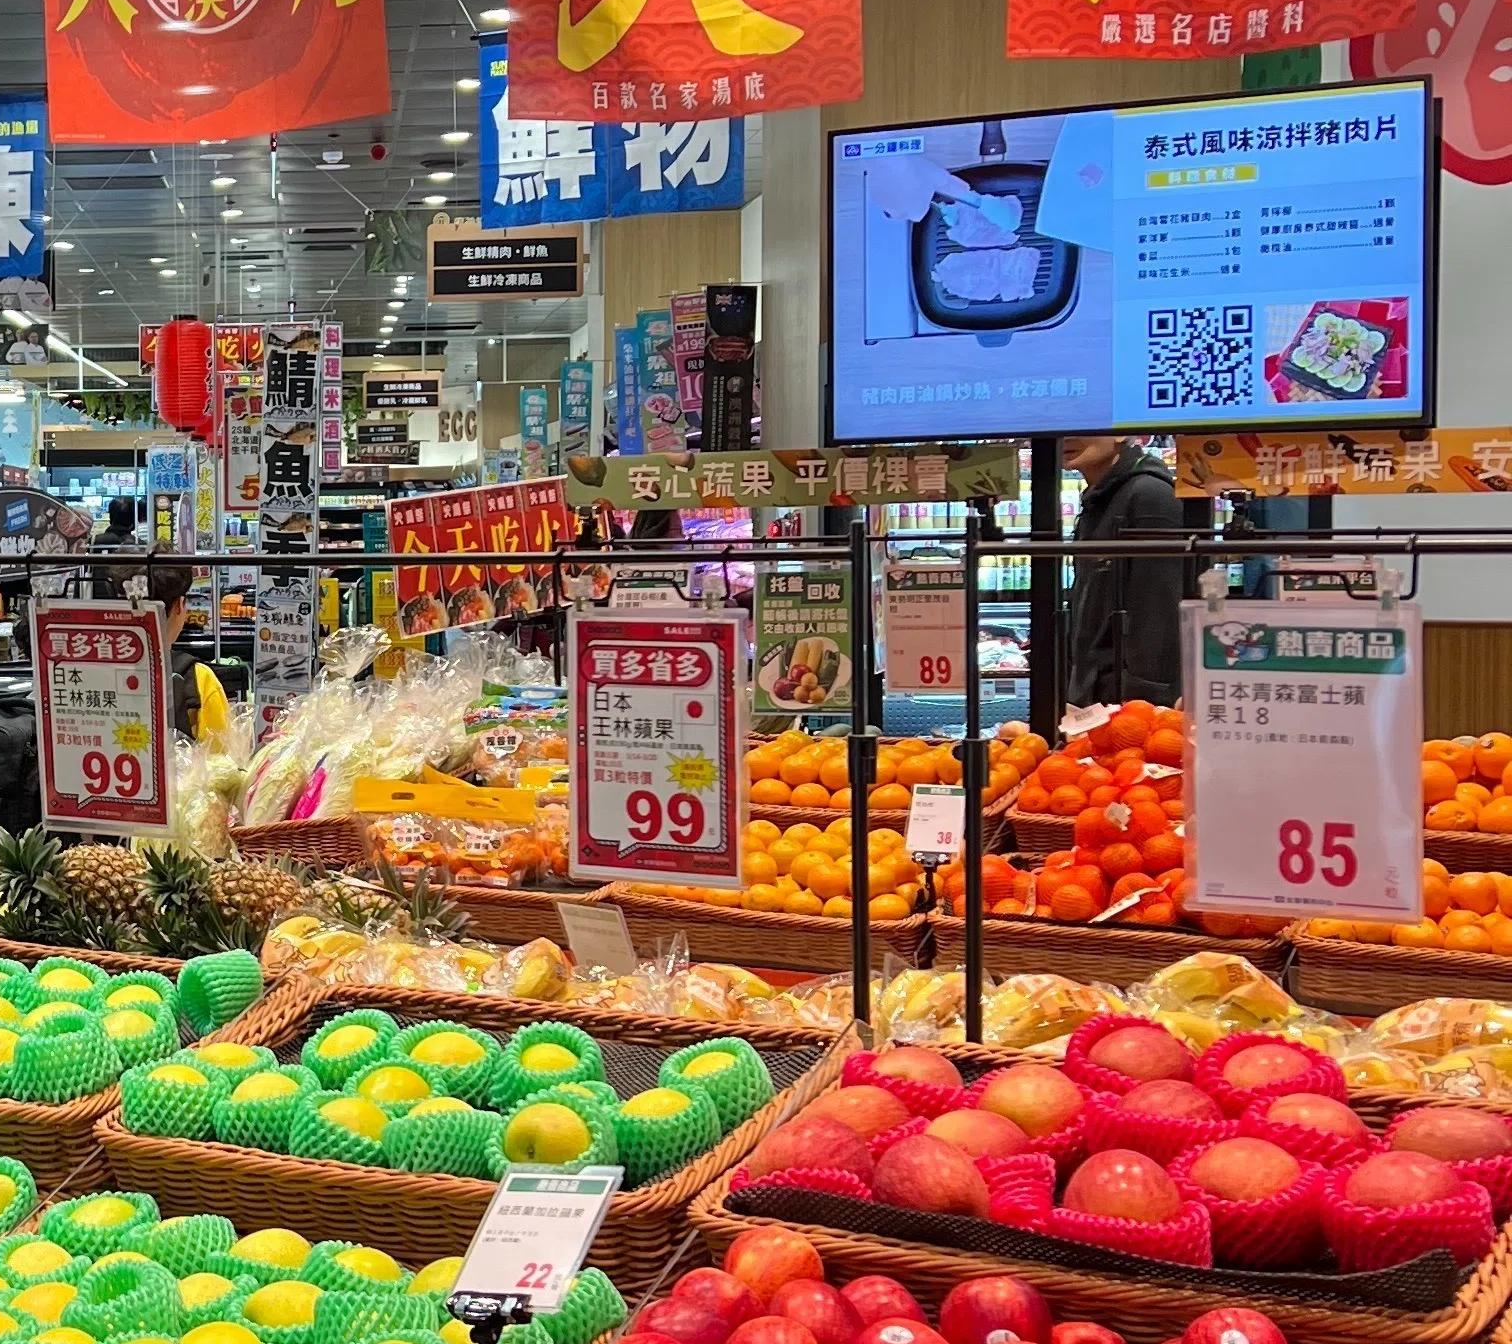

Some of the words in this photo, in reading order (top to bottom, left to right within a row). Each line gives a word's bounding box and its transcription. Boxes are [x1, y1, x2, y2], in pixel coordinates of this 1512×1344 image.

[1100, 0, 1305, 45] 嚴選名店醬料
[592, 72, 765, 111] 百款名家湯底
[492, 87, 732, 206] 鮮物
[1143, 114, 1398, 159] 泰式風味涼拌豬肉片
[468, 273, 543, 288] 生鮮冷凍商品
[438, 410, 477, 443] EGG
[259, 350, 317, 588] 鯖魚季
[794, 454, 949, 497] 平價裸賣
[1255, 440, 1442, 487] 新鮮蔬果
[1473, 439, 1512, 480] 安
[628, 460, 773, 501] 安心蔬果
[807, 583, 841, 600] 回收
[49, 632, 137, 660] 買多省多
[1276, 630, 1396, 659] 熱賣商品
[52, 667, 84, 686] 日本
[592, 649, 703, 683] 買多省多
[920, 656, 951, 684] 89
[53, 688, 118, 709] 王林蘋果
[594, 691, 633, 713] 日本
[1208, 681, 1366, 706] 日本青森富士蘋
[592, 716, 675, 741] 王林蘋果
[82, 751, 142, 798] 99
[626, 790, 705, 844] 99
[937, 831, 953, 844] 38
[1279, 819, 1358, 887] 85
[516, 1262, 553, 1289] 22
